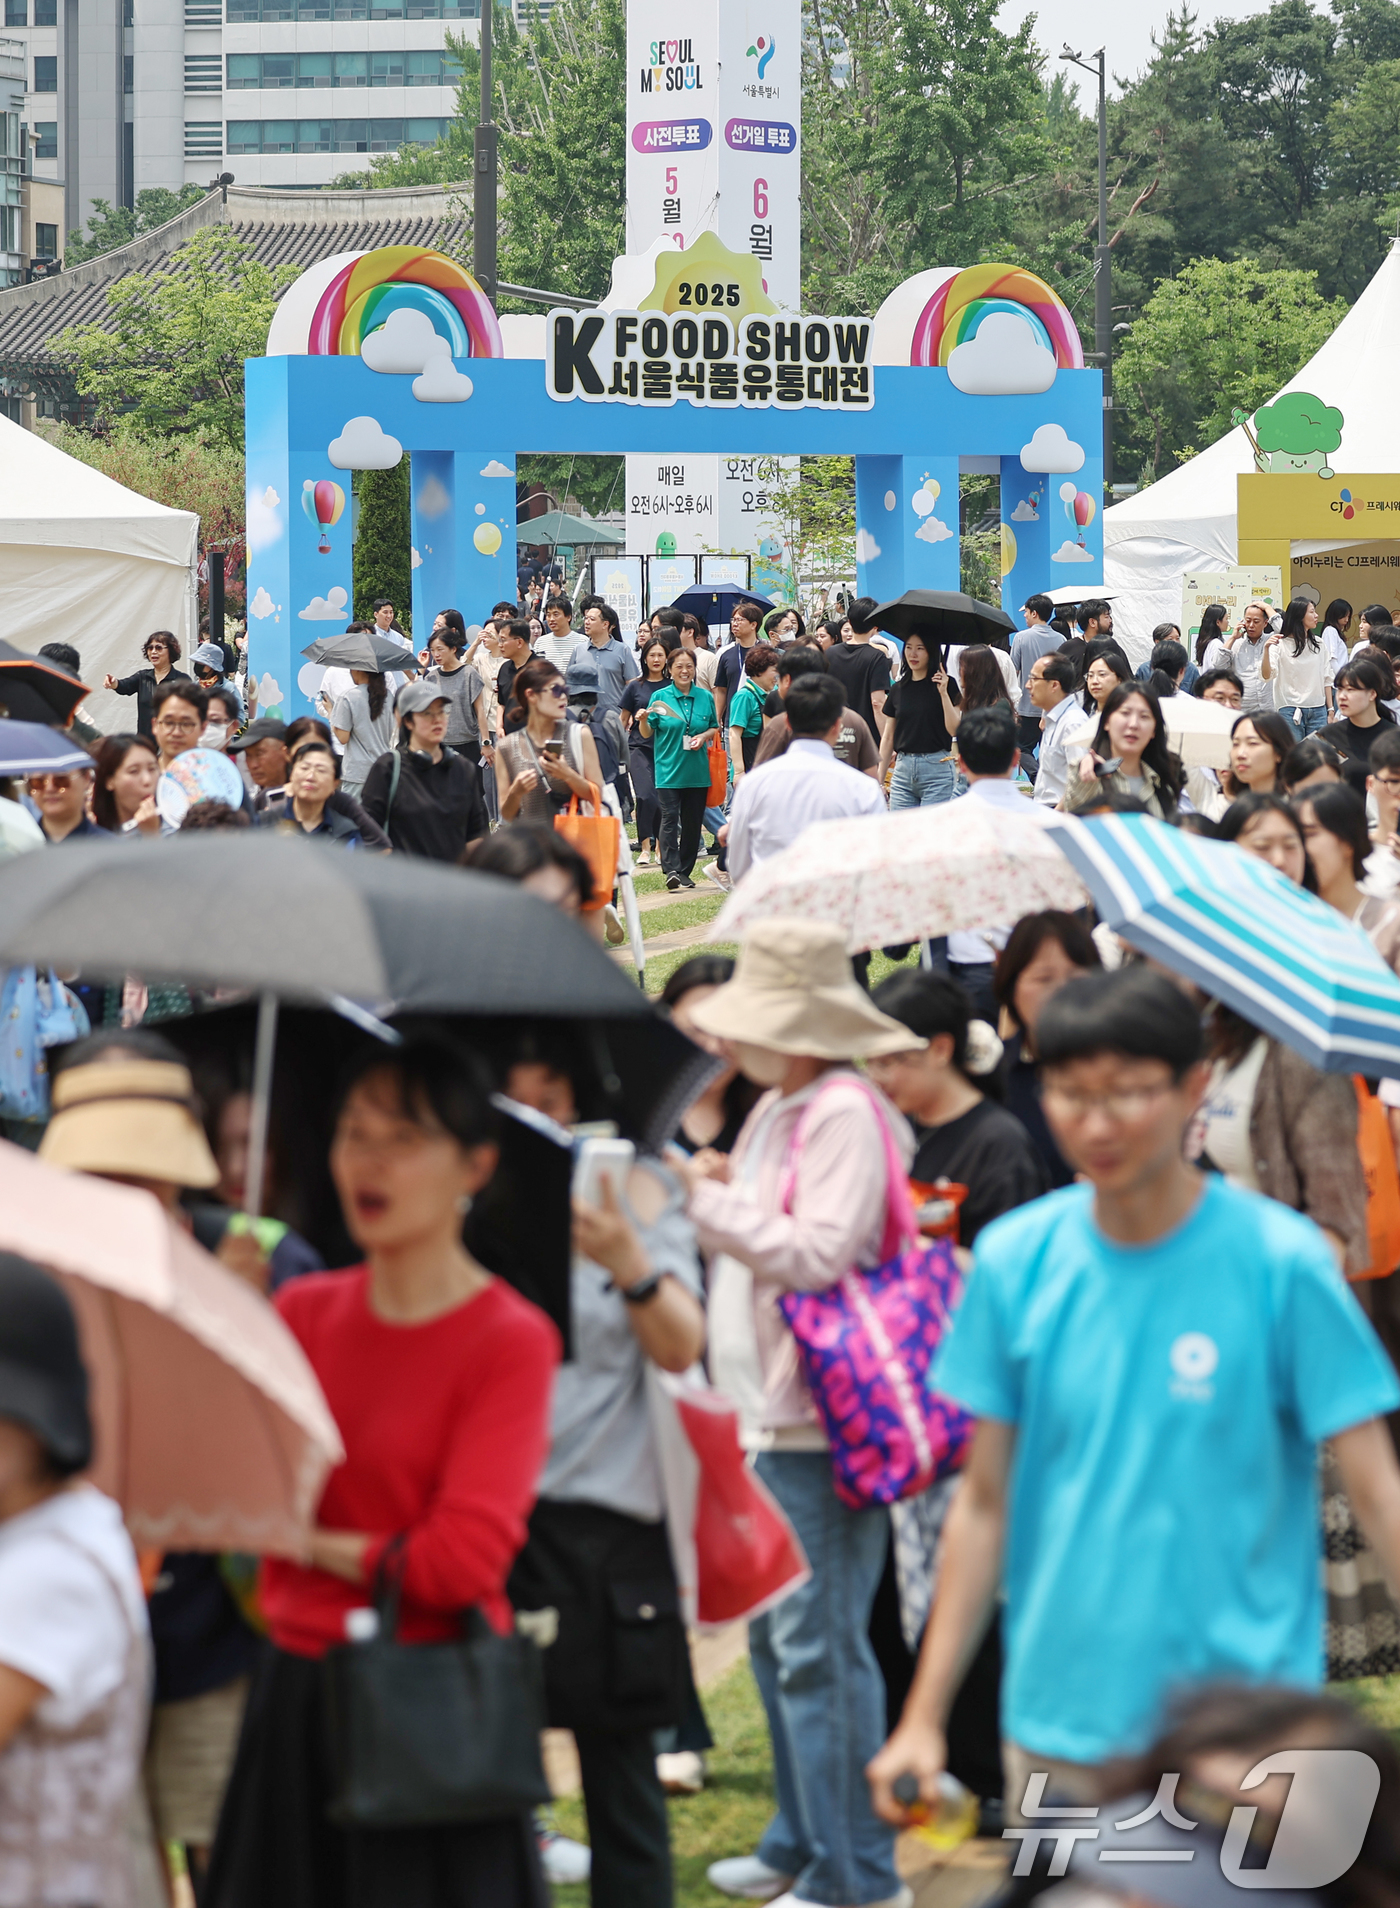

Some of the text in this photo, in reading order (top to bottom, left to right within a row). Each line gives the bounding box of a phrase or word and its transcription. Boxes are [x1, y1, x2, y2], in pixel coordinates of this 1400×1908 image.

[742, 84, 780, 99] 서울특별시
[643, 125, 700, 147] 사전투표
[731, 124, 790, 148] 선거일 투표
[678, 282, 740, 307] 2025
[555, 316, 870, 395] K FOOD SHOW
[608, 361, 869, 403] 서울식품유통대전
[658, 465, 685, 487] 매일
[630, 494, 650, 516] 오전
[696, 494, 713, 516] 6시
[1330, 501, 1344, 513] CJ
[1293, 556, 1344, 568] 아이누리는
[1195, 594, 1237, 607] 아이누리
